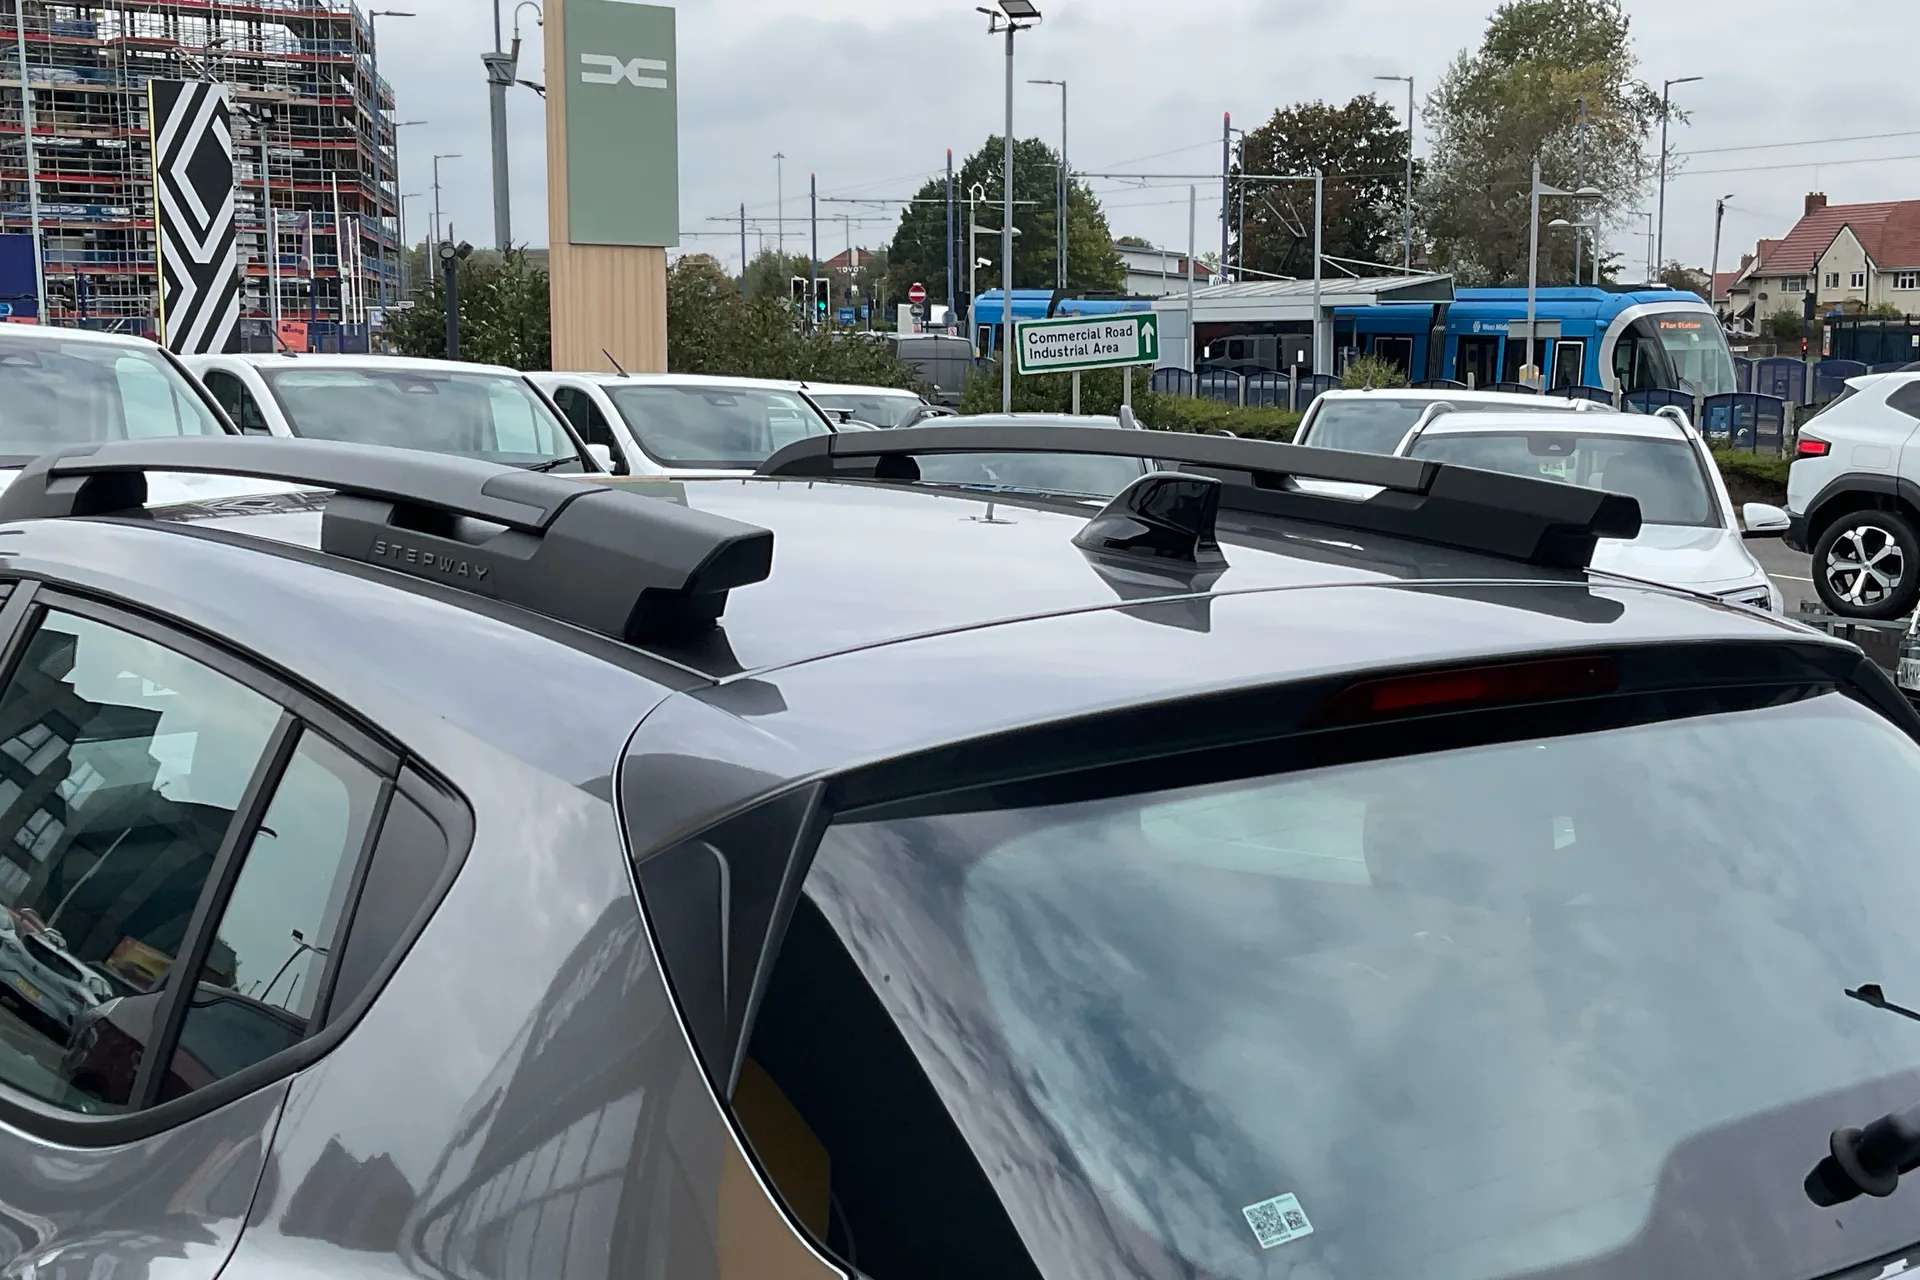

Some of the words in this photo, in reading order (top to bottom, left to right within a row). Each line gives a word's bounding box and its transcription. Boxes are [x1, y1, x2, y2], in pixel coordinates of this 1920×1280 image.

[1028, 328, 1101, 345] Commercial
[1105, 325, 1133, 338] Road
[1029, 344, 1089, 360] Industrial
[1093, 343, 1119, 354] Area
[375, 540, 489, 580] STEPWAY
